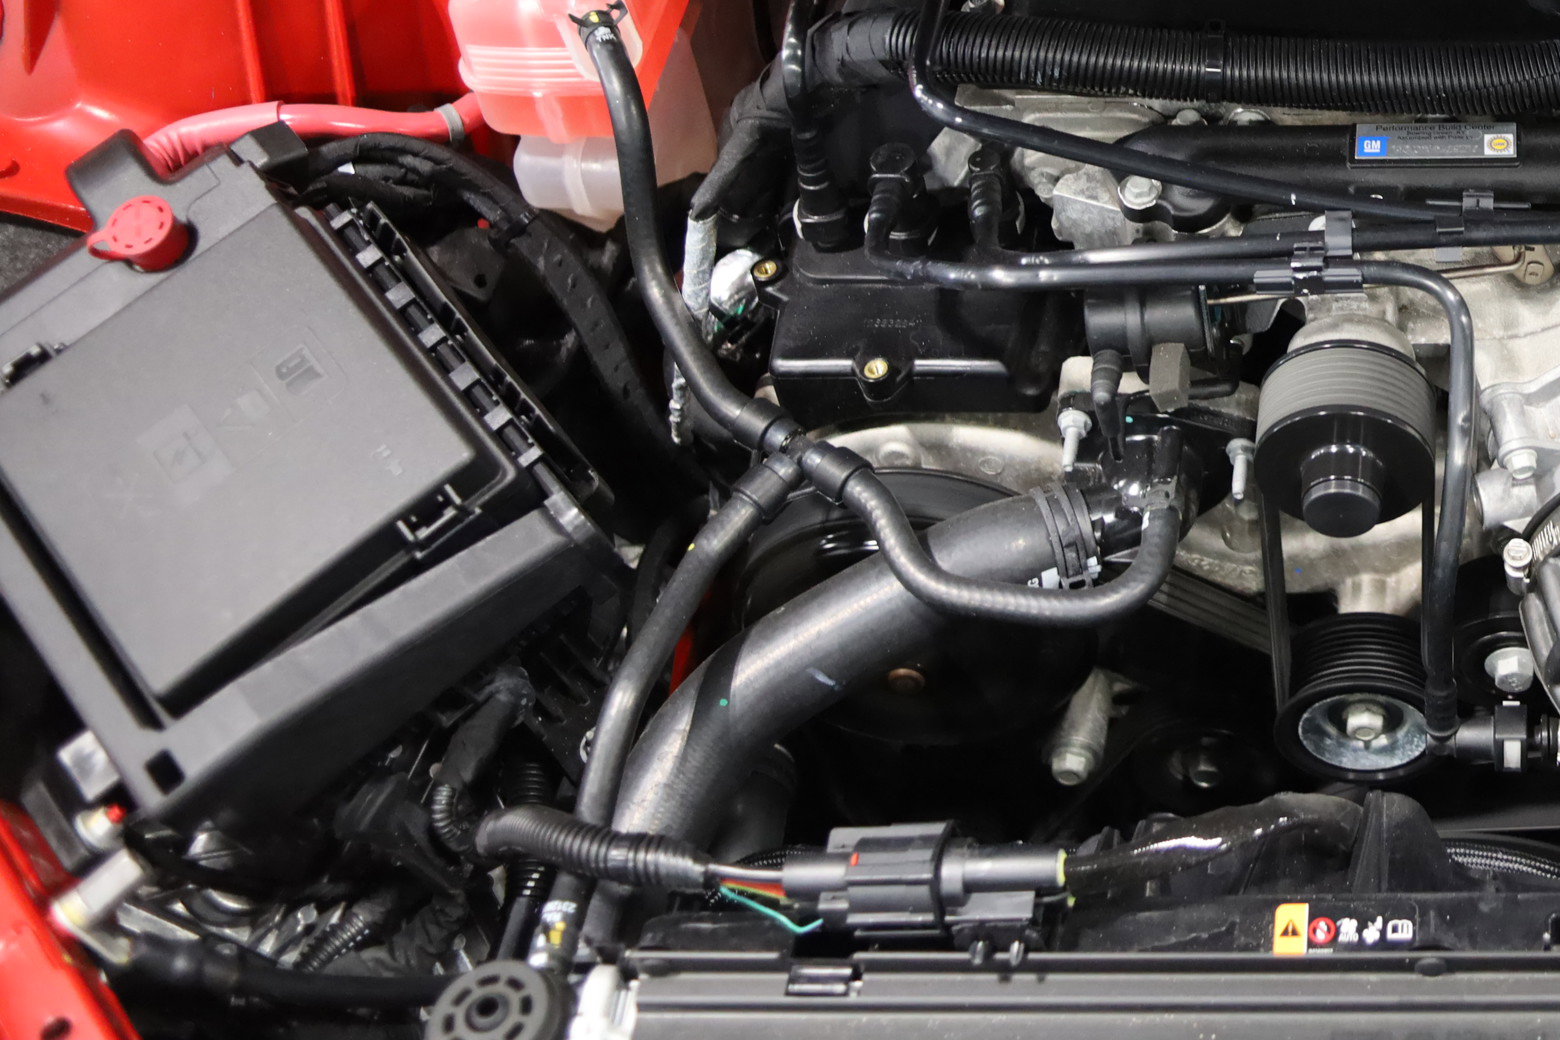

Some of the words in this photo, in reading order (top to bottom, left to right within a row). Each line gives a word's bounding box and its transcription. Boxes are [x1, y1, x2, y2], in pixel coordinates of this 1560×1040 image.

[1375, 124, 1436, 132] Performance
[1438, 124, 1462, 132] Build
[1464, 124, 1496, 132] Center
[1363, 140, 1381, 149] GM
